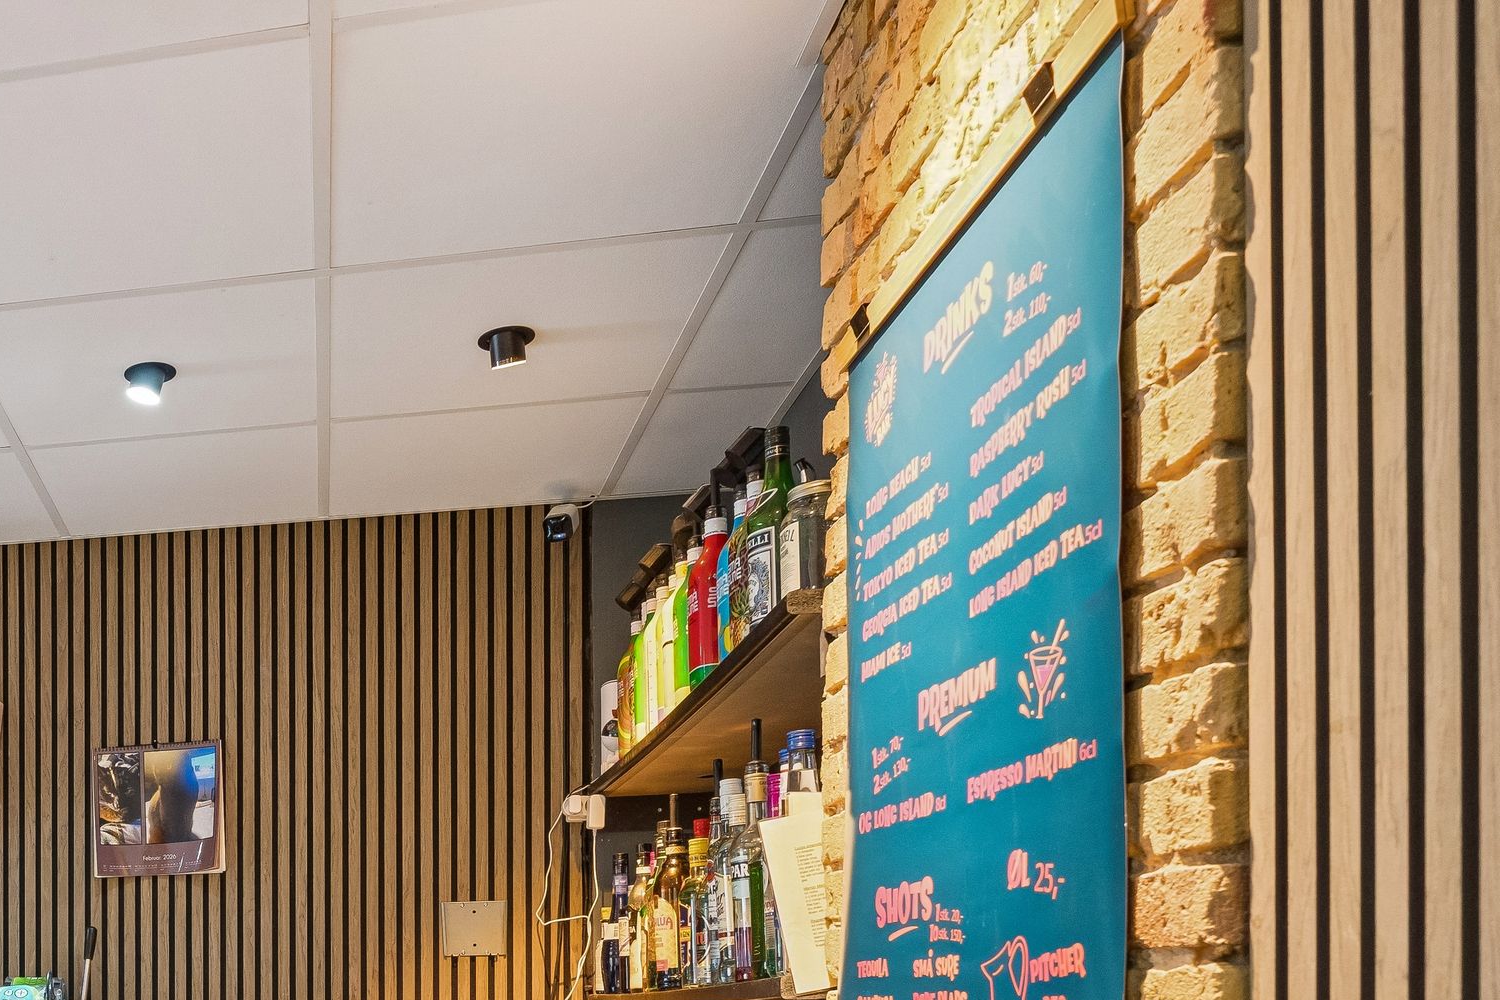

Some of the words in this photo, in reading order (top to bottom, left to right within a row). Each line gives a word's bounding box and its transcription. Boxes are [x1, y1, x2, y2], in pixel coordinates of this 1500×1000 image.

[923, 261, 994, 374] DRINKS
[970, 359, 1022, 428] TROPICAL
[1024, 315, 1068, 379] ISLAND
[970, 401, 1034, 478] RASPBERRY
[1035, 365, 1071, 419] RUSH
[968, 484, 1000, 526] DARK
[1001, 456, 1031, 500] LUCY
[863, 566, 893, 602] TOKYO
[894, 547, 916, 582] ICED
[917, 533, 939, 565] TEA
[968, 522, 1016, 576] COCONUT
[1016, 492, 1054, 541] ISLAND
[968, 591, 996, 618] LONG
[996, 558, 1033, 602] ISLAND
[1033, 540, 1058, 576] ICED
[1060, 525, 1086, 559] TEA
[1083, 519, 1103, 545] 5cl
[862, 603, 898, 641] GEORGIA
[899, 587, 921, 618] ICED
[921, 574, 941, 604] TEA
[886, 642, 901, 664] ICE
[917, 657, 997, 732] PREMIUM
[967, 761, 1024, 804] ESPRESSO
[1025, 737, 1079, 783] MARTINI
[874, 804, 897, 829] LONG
[899, 791, 935, 824] ISLAND
[875, 876, 934, 929] SHOTS
[1007, 848, 1030, 890] ØL
[1034, 862, 1065, 900] 25,-
[857, 957, 889, 979] TEQUILA
[913, 949, 934, 979] SMÅ
[935, 954, 960, 982] SURE
[1030, 943, 1086, 984] PITCHER
